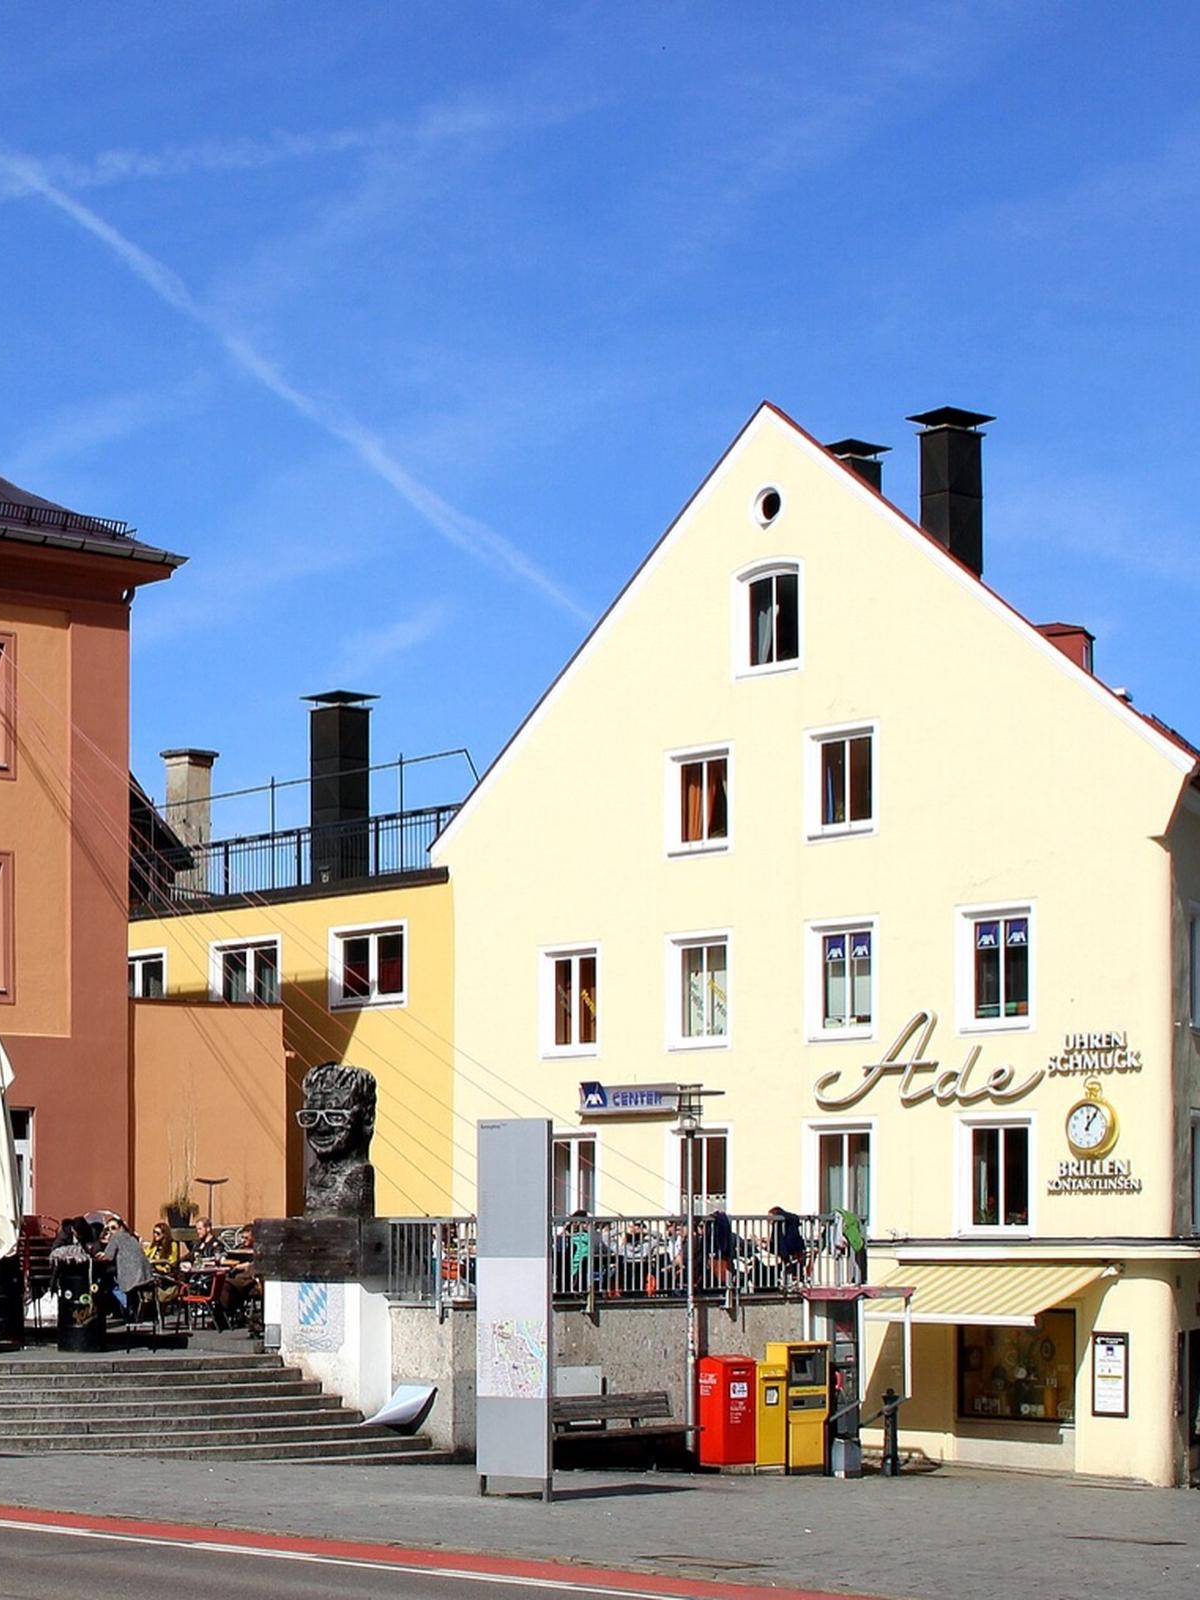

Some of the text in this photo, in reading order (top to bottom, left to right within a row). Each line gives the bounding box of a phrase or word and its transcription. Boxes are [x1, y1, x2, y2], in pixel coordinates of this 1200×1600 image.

[1064, 1031, 1128, 1053] UHREN
[813, 1007, 1046, 1107] Ade
[1048, 1050, 1143, 1075] SCHMUCK
[612, 1090, 663, 1107] CENTER
[1057, 1158, 1131, 1178] BRILLEN
[1047, 1177, 1142, 1194] KONTAKTLINSEN
